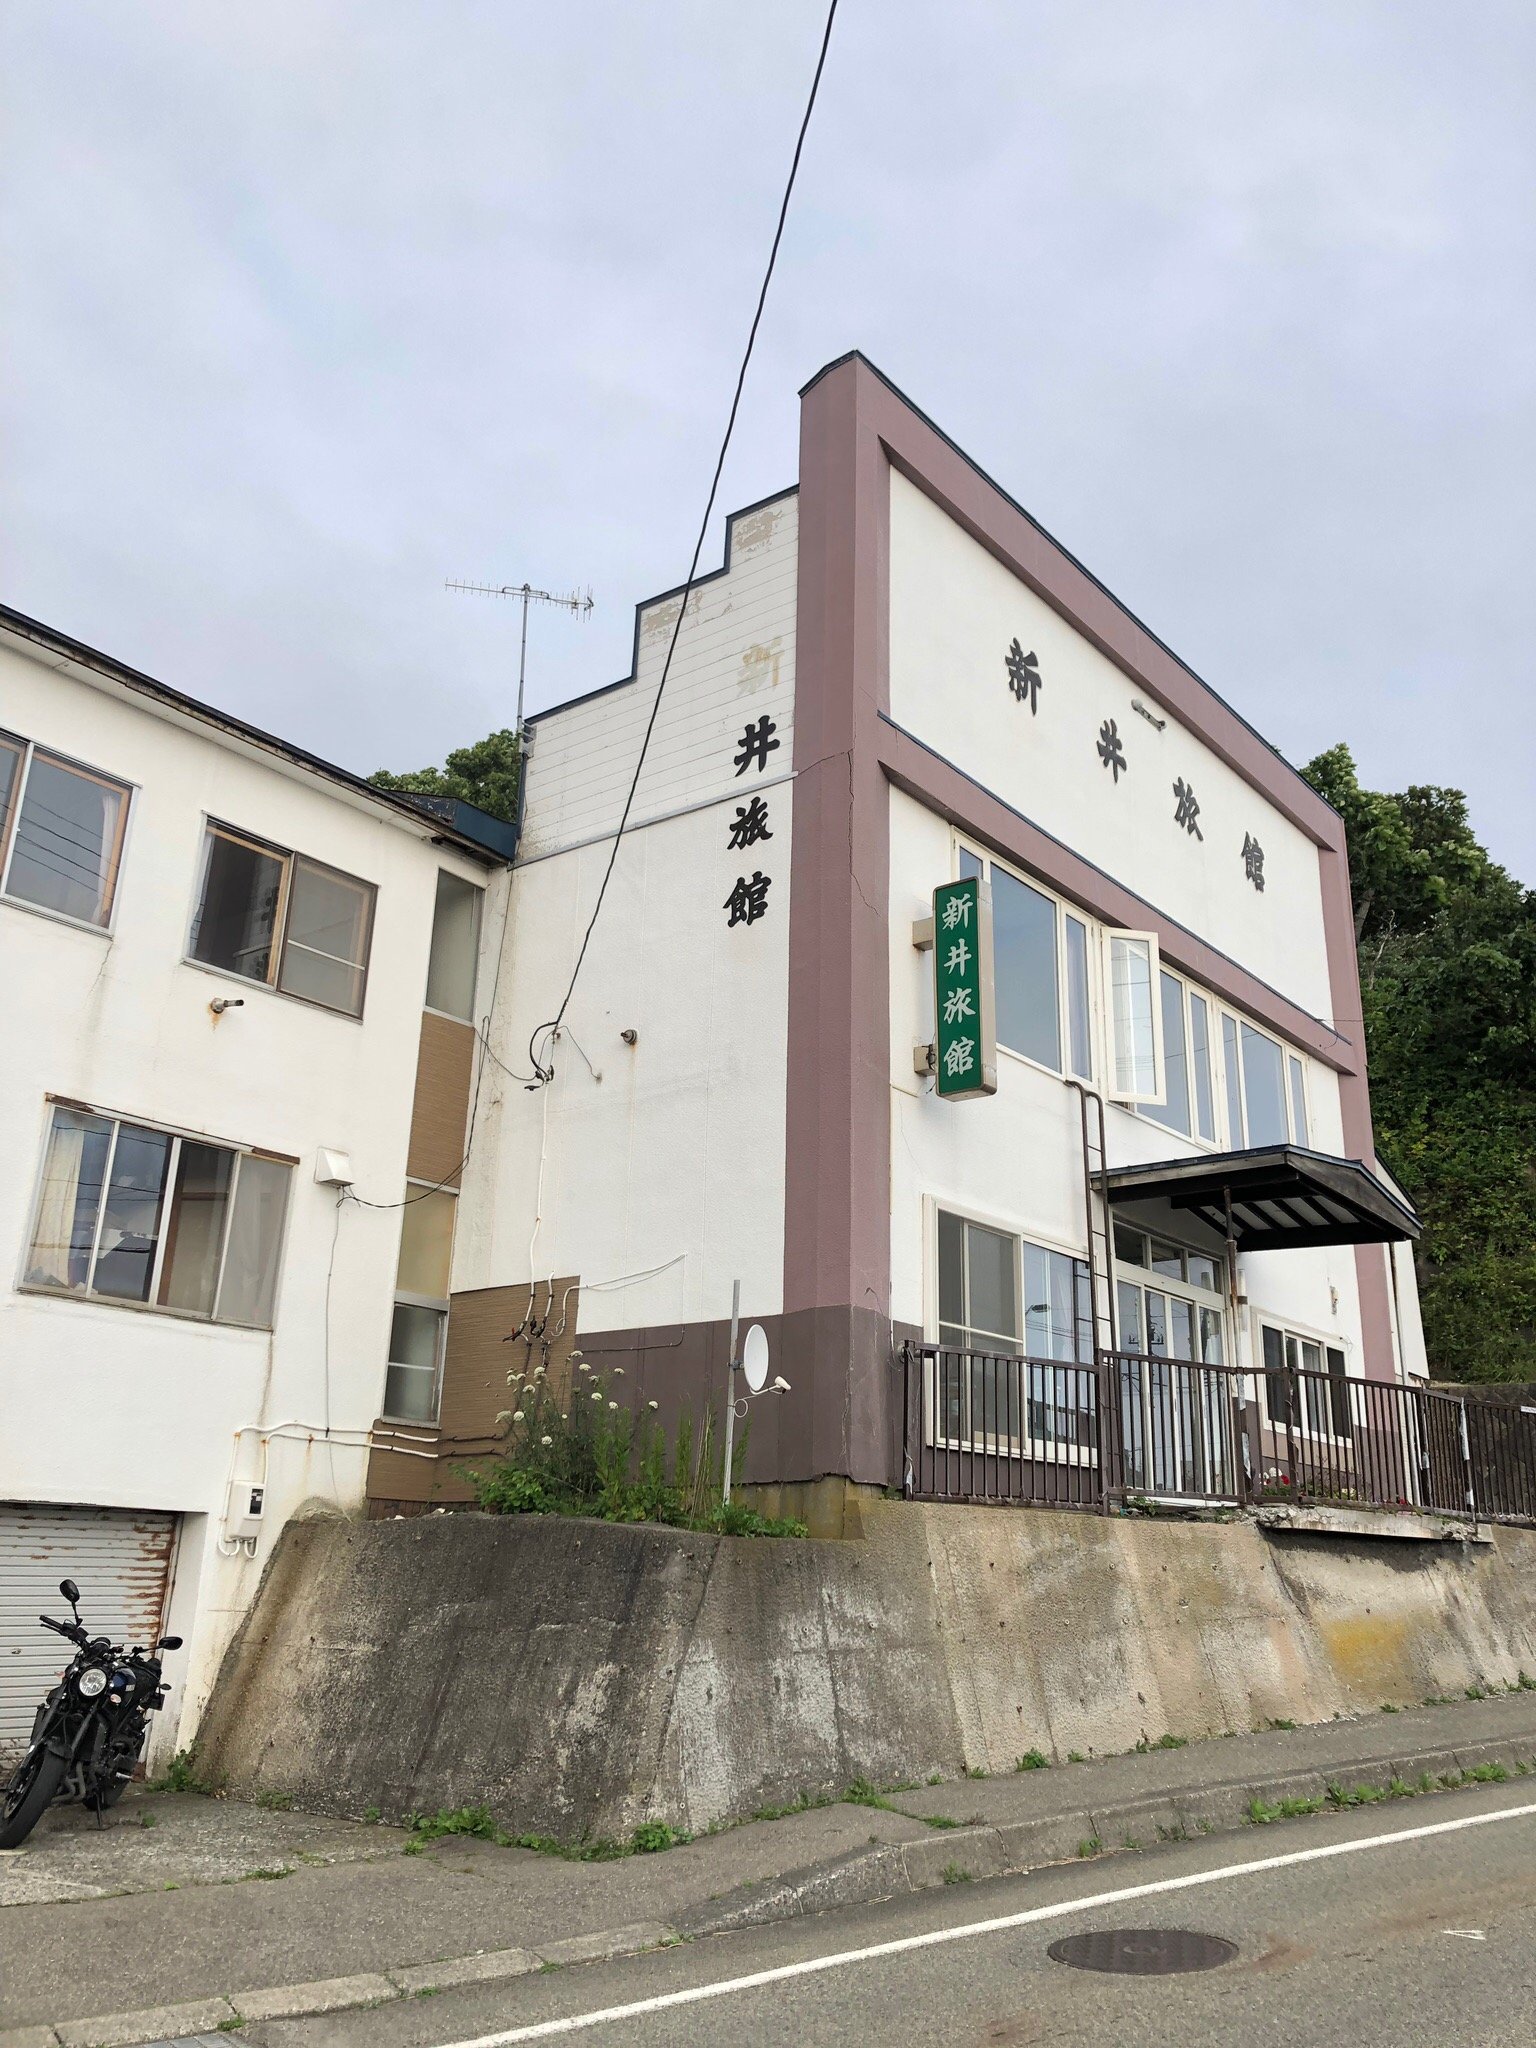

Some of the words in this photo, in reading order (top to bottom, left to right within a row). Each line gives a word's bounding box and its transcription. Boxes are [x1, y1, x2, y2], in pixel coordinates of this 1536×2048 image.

[1005, 637, 1265, 892] 新井旅館
[942, 893, 976, 1077] 新井旅館
